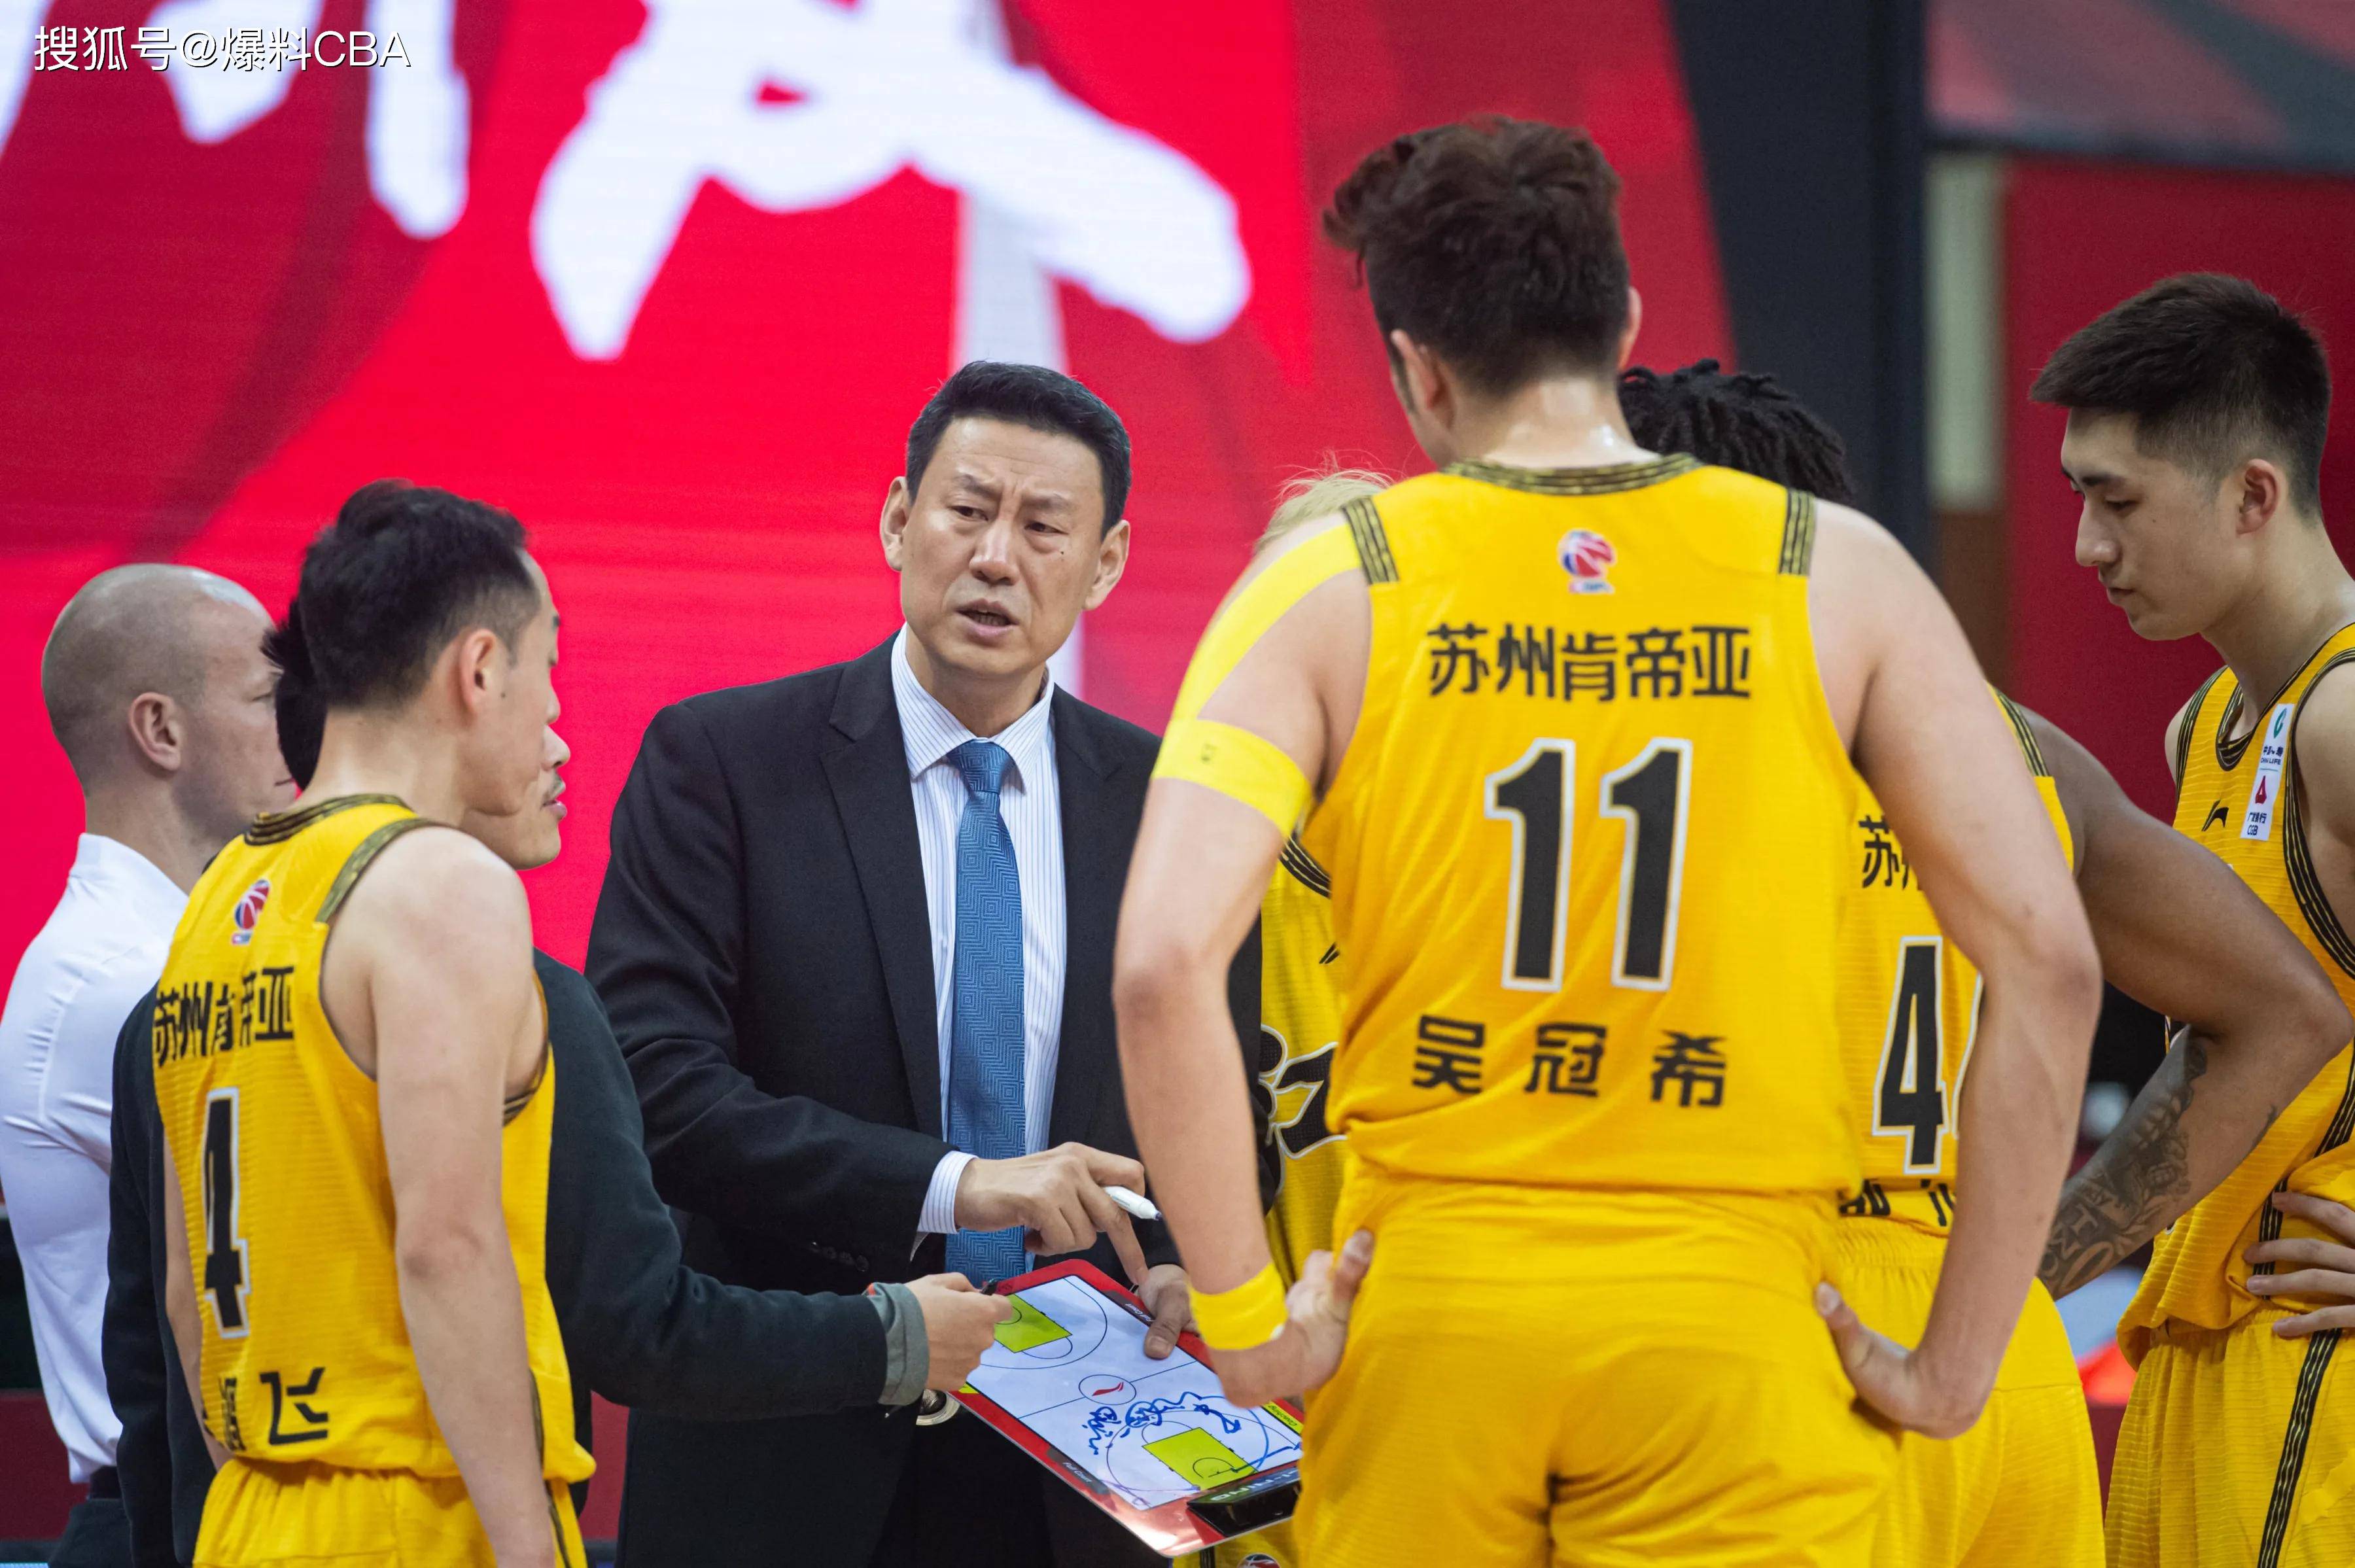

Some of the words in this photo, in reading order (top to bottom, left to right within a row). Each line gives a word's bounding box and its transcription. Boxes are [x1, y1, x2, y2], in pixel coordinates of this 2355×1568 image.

[1427, 622, 1752, 701] 苏州肯帝亚
[1484, 737, 1693, 992] 11
[1858, 814, 1910, 890] 苏
[1411, 1015, 1727, 1108] 吴冠希
[1872, 936, 1983, 1175] 4
[200, 1087, 252, 1339] 4
